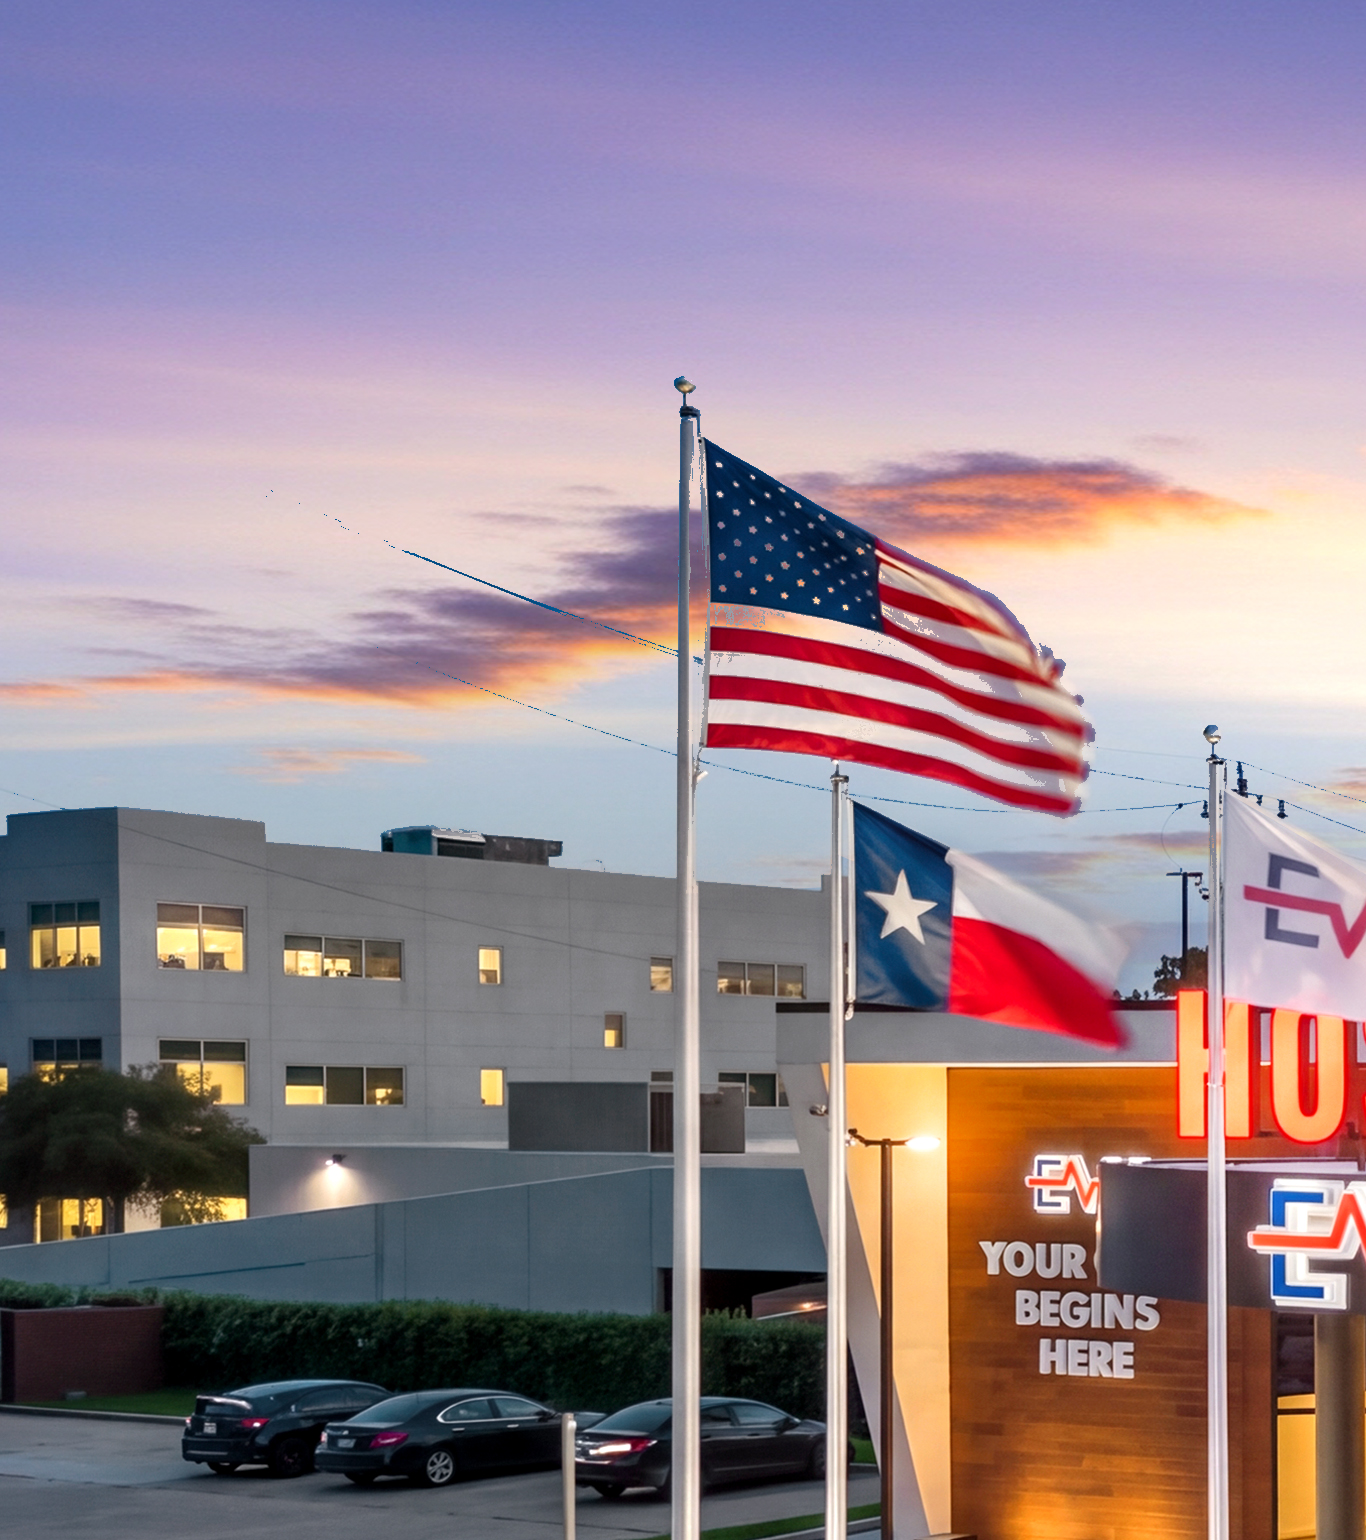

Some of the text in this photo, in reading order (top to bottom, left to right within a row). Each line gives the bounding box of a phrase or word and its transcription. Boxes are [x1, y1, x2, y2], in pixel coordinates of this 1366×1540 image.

[979, 1241, 1087, 1279] YOUR
[1015, 1290, 1160, 1331] BEGINS
[1039, 1339, 1134, 1379] HERE
